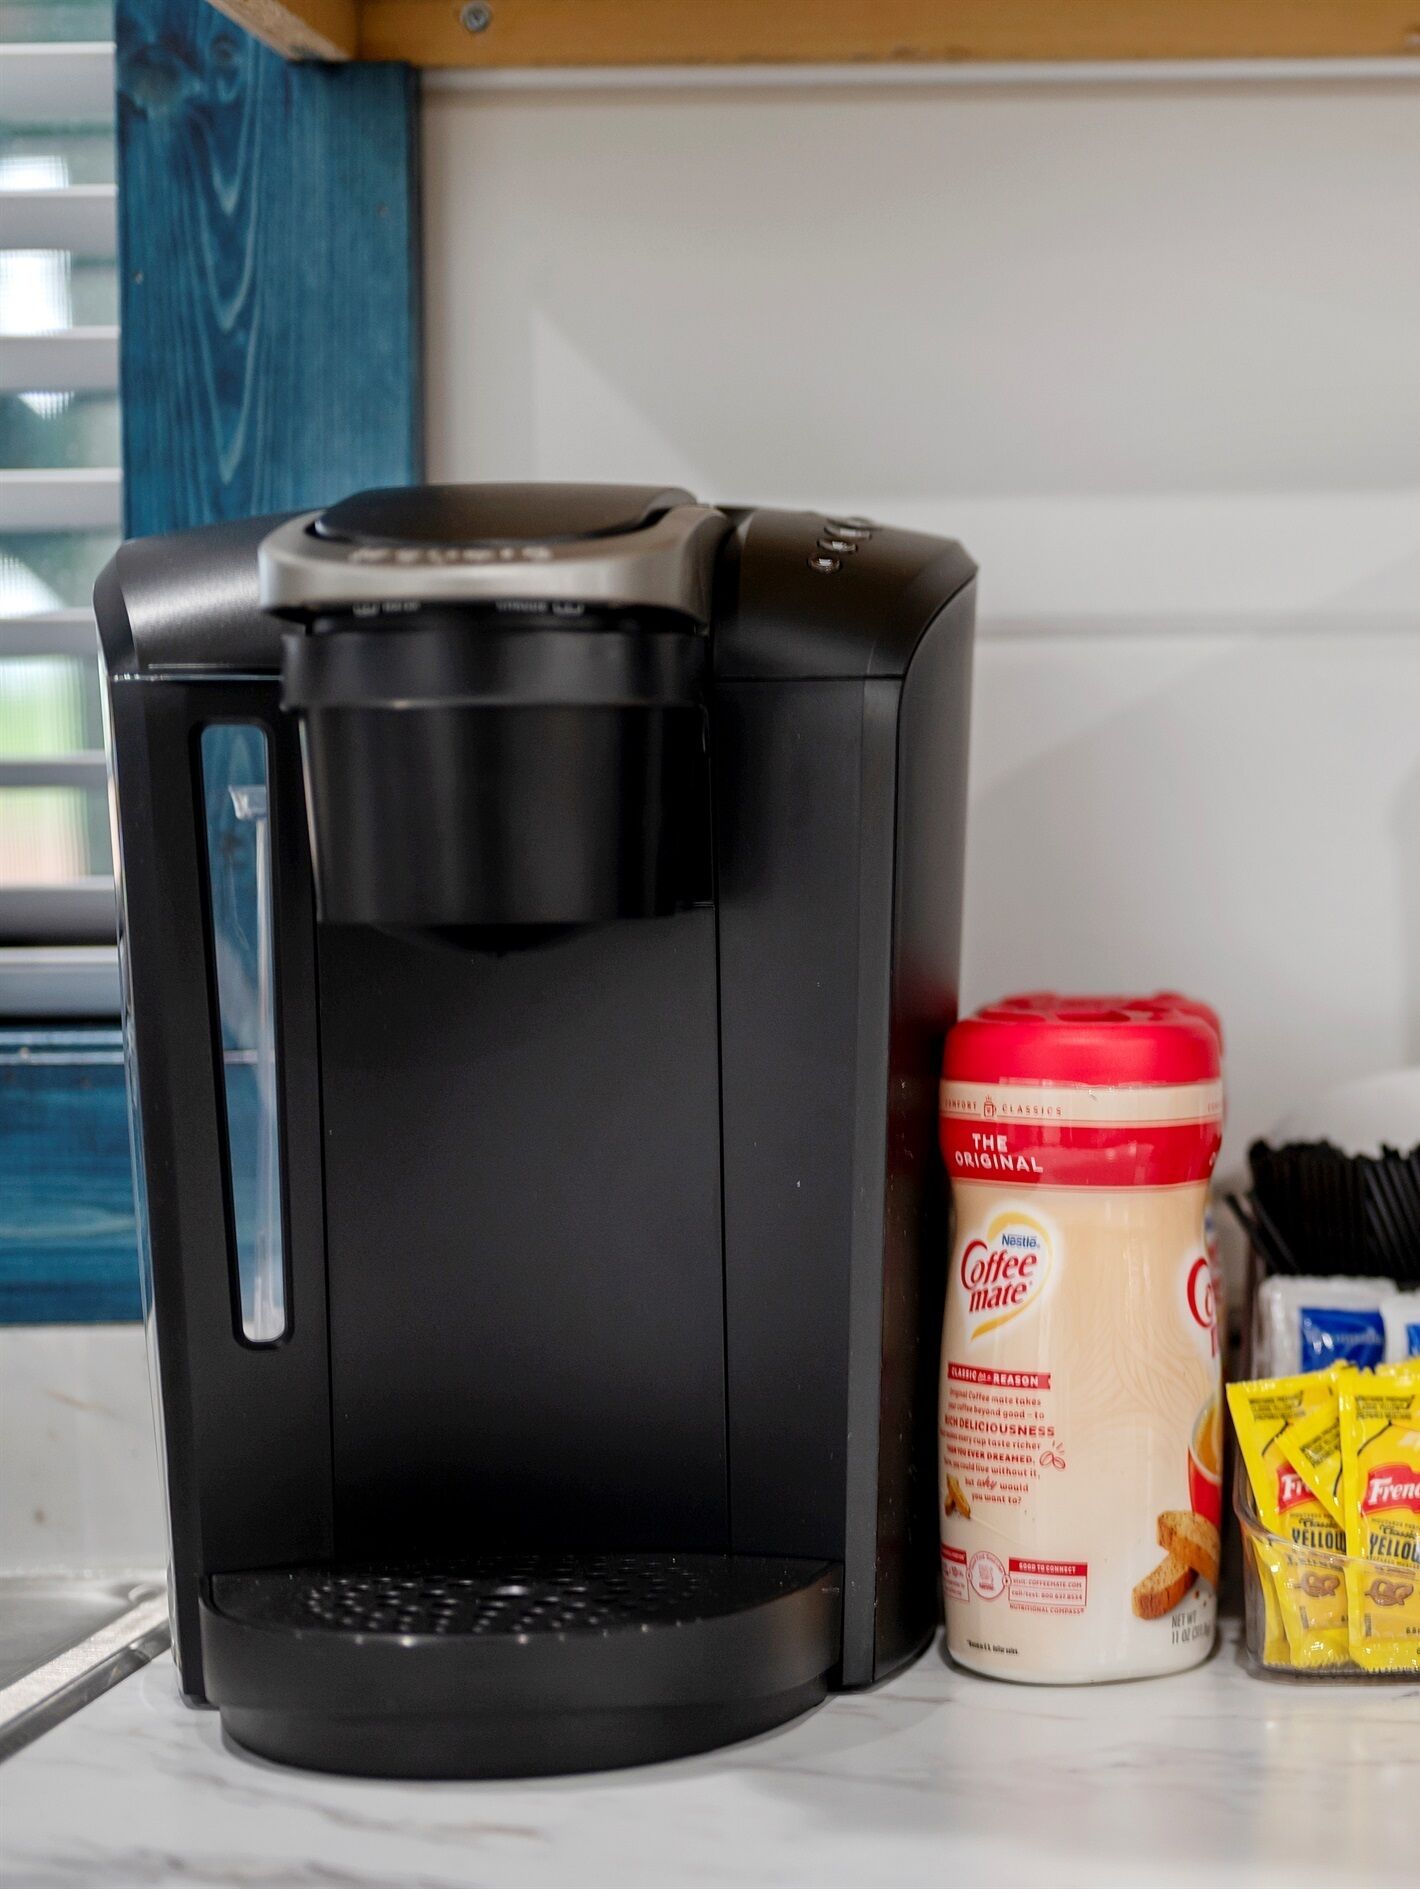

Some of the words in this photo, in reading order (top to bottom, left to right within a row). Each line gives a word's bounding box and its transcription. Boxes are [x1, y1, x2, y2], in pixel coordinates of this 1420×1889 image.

[1002, 1104, 1062, 1115] CLASSICS
[972, 1132, 1008, 1153] THE
[955, 1150, 1044, 1173] ORIGINAL
[961, 1238, 1037, 1290] Coffee
[969, 1281, 1027, 1313] mate
[951, 1366, 977, 1381] CLASSIC
[993, 1373, 1039, 1388] REASON
[959, 1417, 1055, 1437] DELICIOUSNESS
